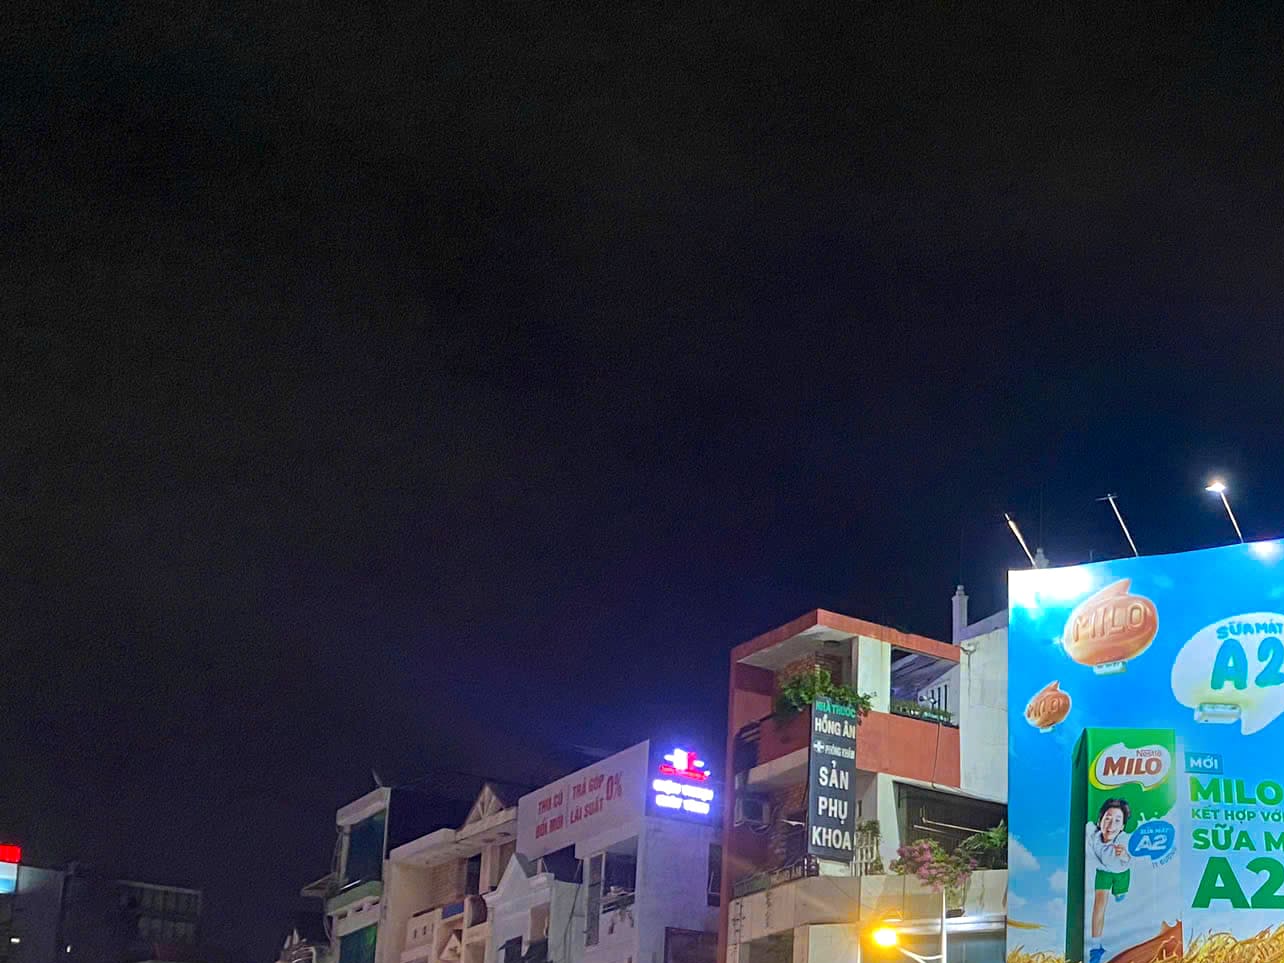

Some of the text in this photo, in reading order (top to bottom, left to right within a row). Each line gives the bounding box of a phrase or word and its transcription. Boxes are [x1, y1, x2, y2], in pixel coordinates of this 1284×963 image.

[1073, 601, 1145, 642] MILO
[819, 760, 849, 790] SẢN
[1103, 756, 1162, 776] MILO
[1190, 755, 1218, 769] MỚI
[1189, 776, 1284, 806] MILO
[818, 796, 848, 825] PHỤ
[1191, 804, 1220, 820] KẾT
[1224, 808, 1256, 824] HỢP
[811, 826, 852, 851] KHOA
[1135, 834, 1168, 851] A2
[1192, 823, 1257, 851] SỮA
